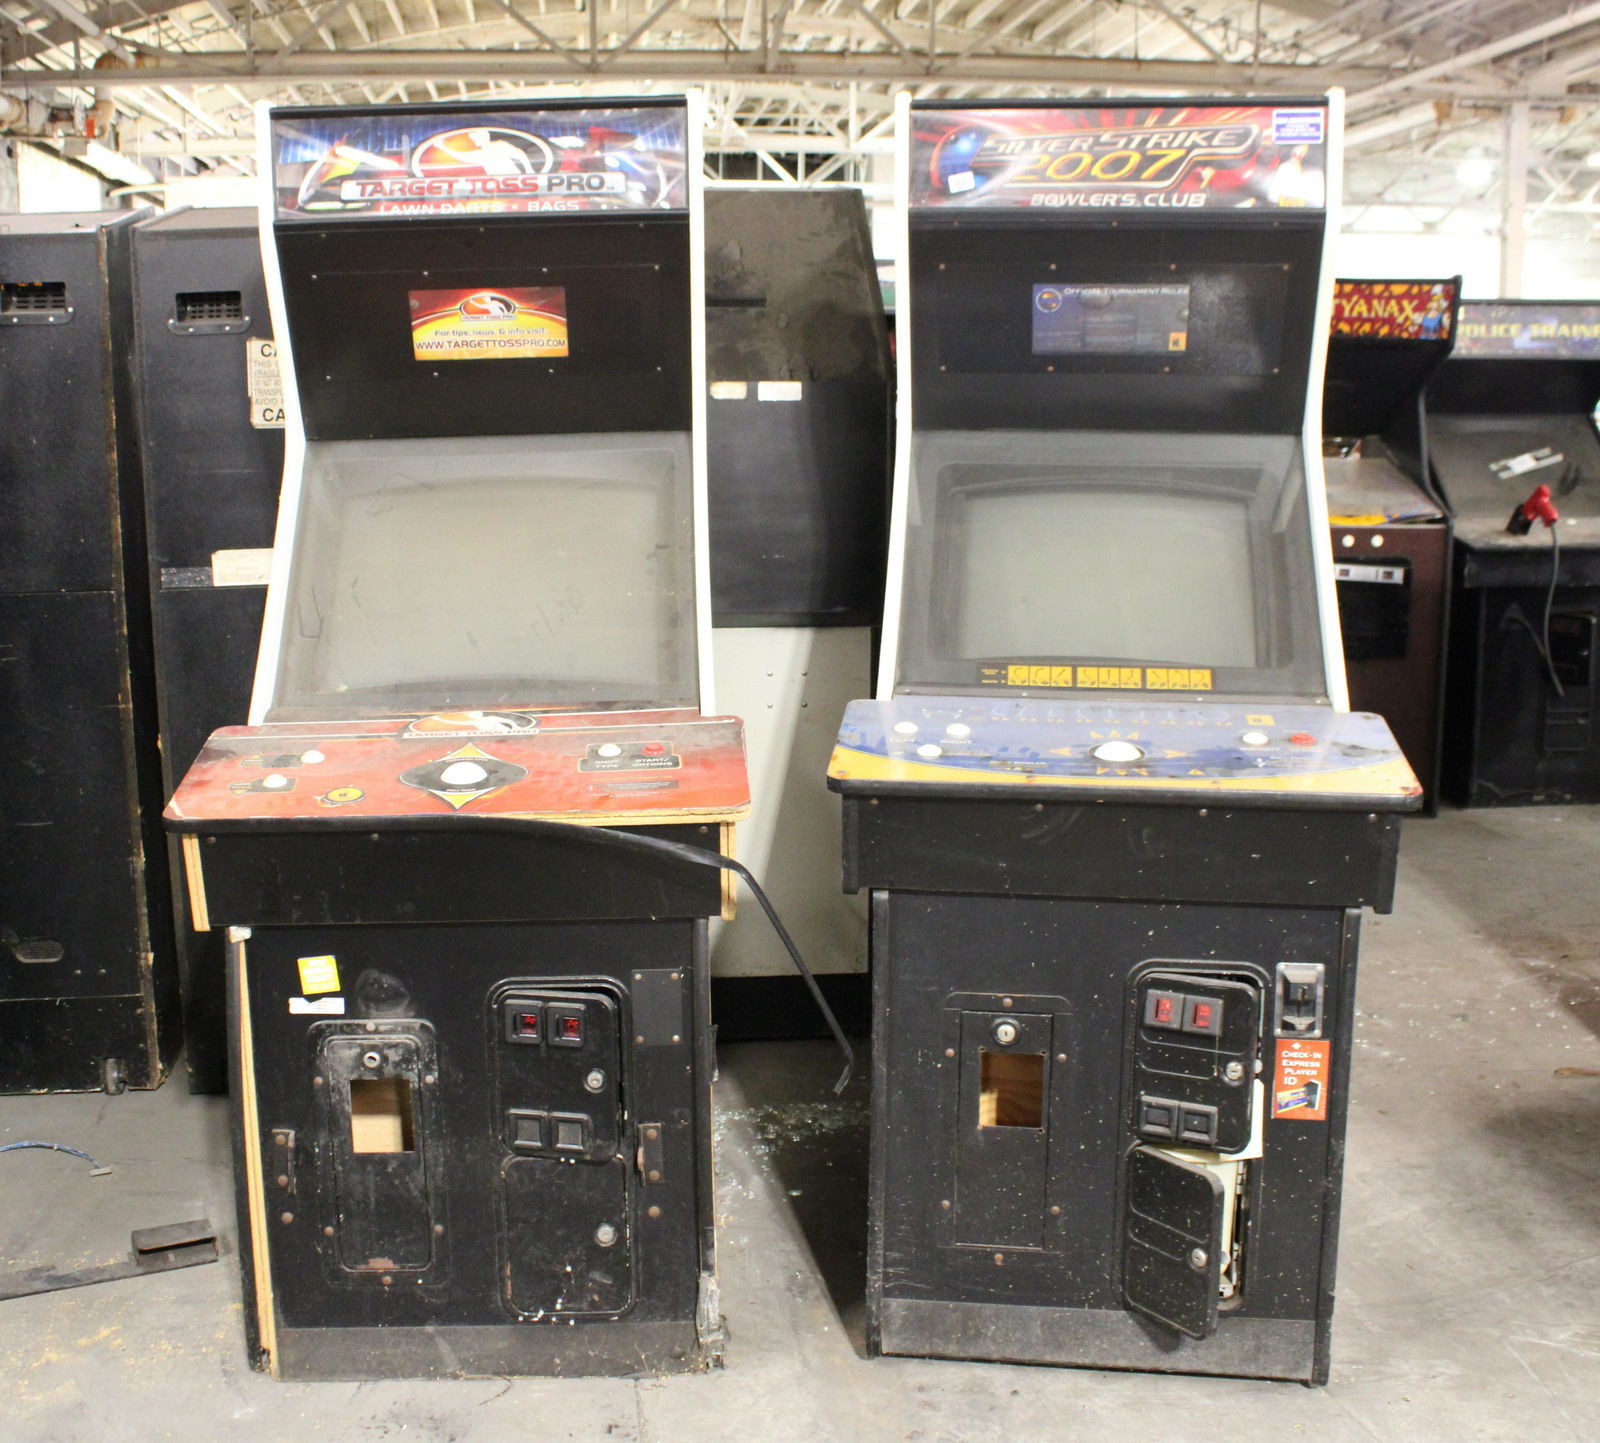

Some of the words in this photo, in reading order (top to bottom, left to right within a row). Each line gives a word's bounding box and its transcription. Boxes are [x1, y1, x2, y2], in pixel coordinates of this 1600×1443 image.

[985, 134, 1094, 154] SILVER
[1100, 128, 1243, 150] STRIKE
[1012, 148, 1188, 180] 2007
[356, 180, 458, 197] TARGET
[464, 177, 540, 194] TOSS
[546, 174, 606, 192] PRO
[1030, 192, 1137, 208] BOWLER'S
[1143, 192, 1208, 208] CLUB
[380, 202, 435, 216] LAWN
[440, 201, 504, 214] DARTS
[527, 200, 580, 213] BAGS
[507, 328, 525, 336] info
[416, 339, 566, 350] WWW.TARGETTOSSPRO.COM
[1282, 1059, 1320, 1067] EXPRESS
[1284, 1068, 1317, 1076] PLAYER
[1284, 1077, 1297, 1085] ID
